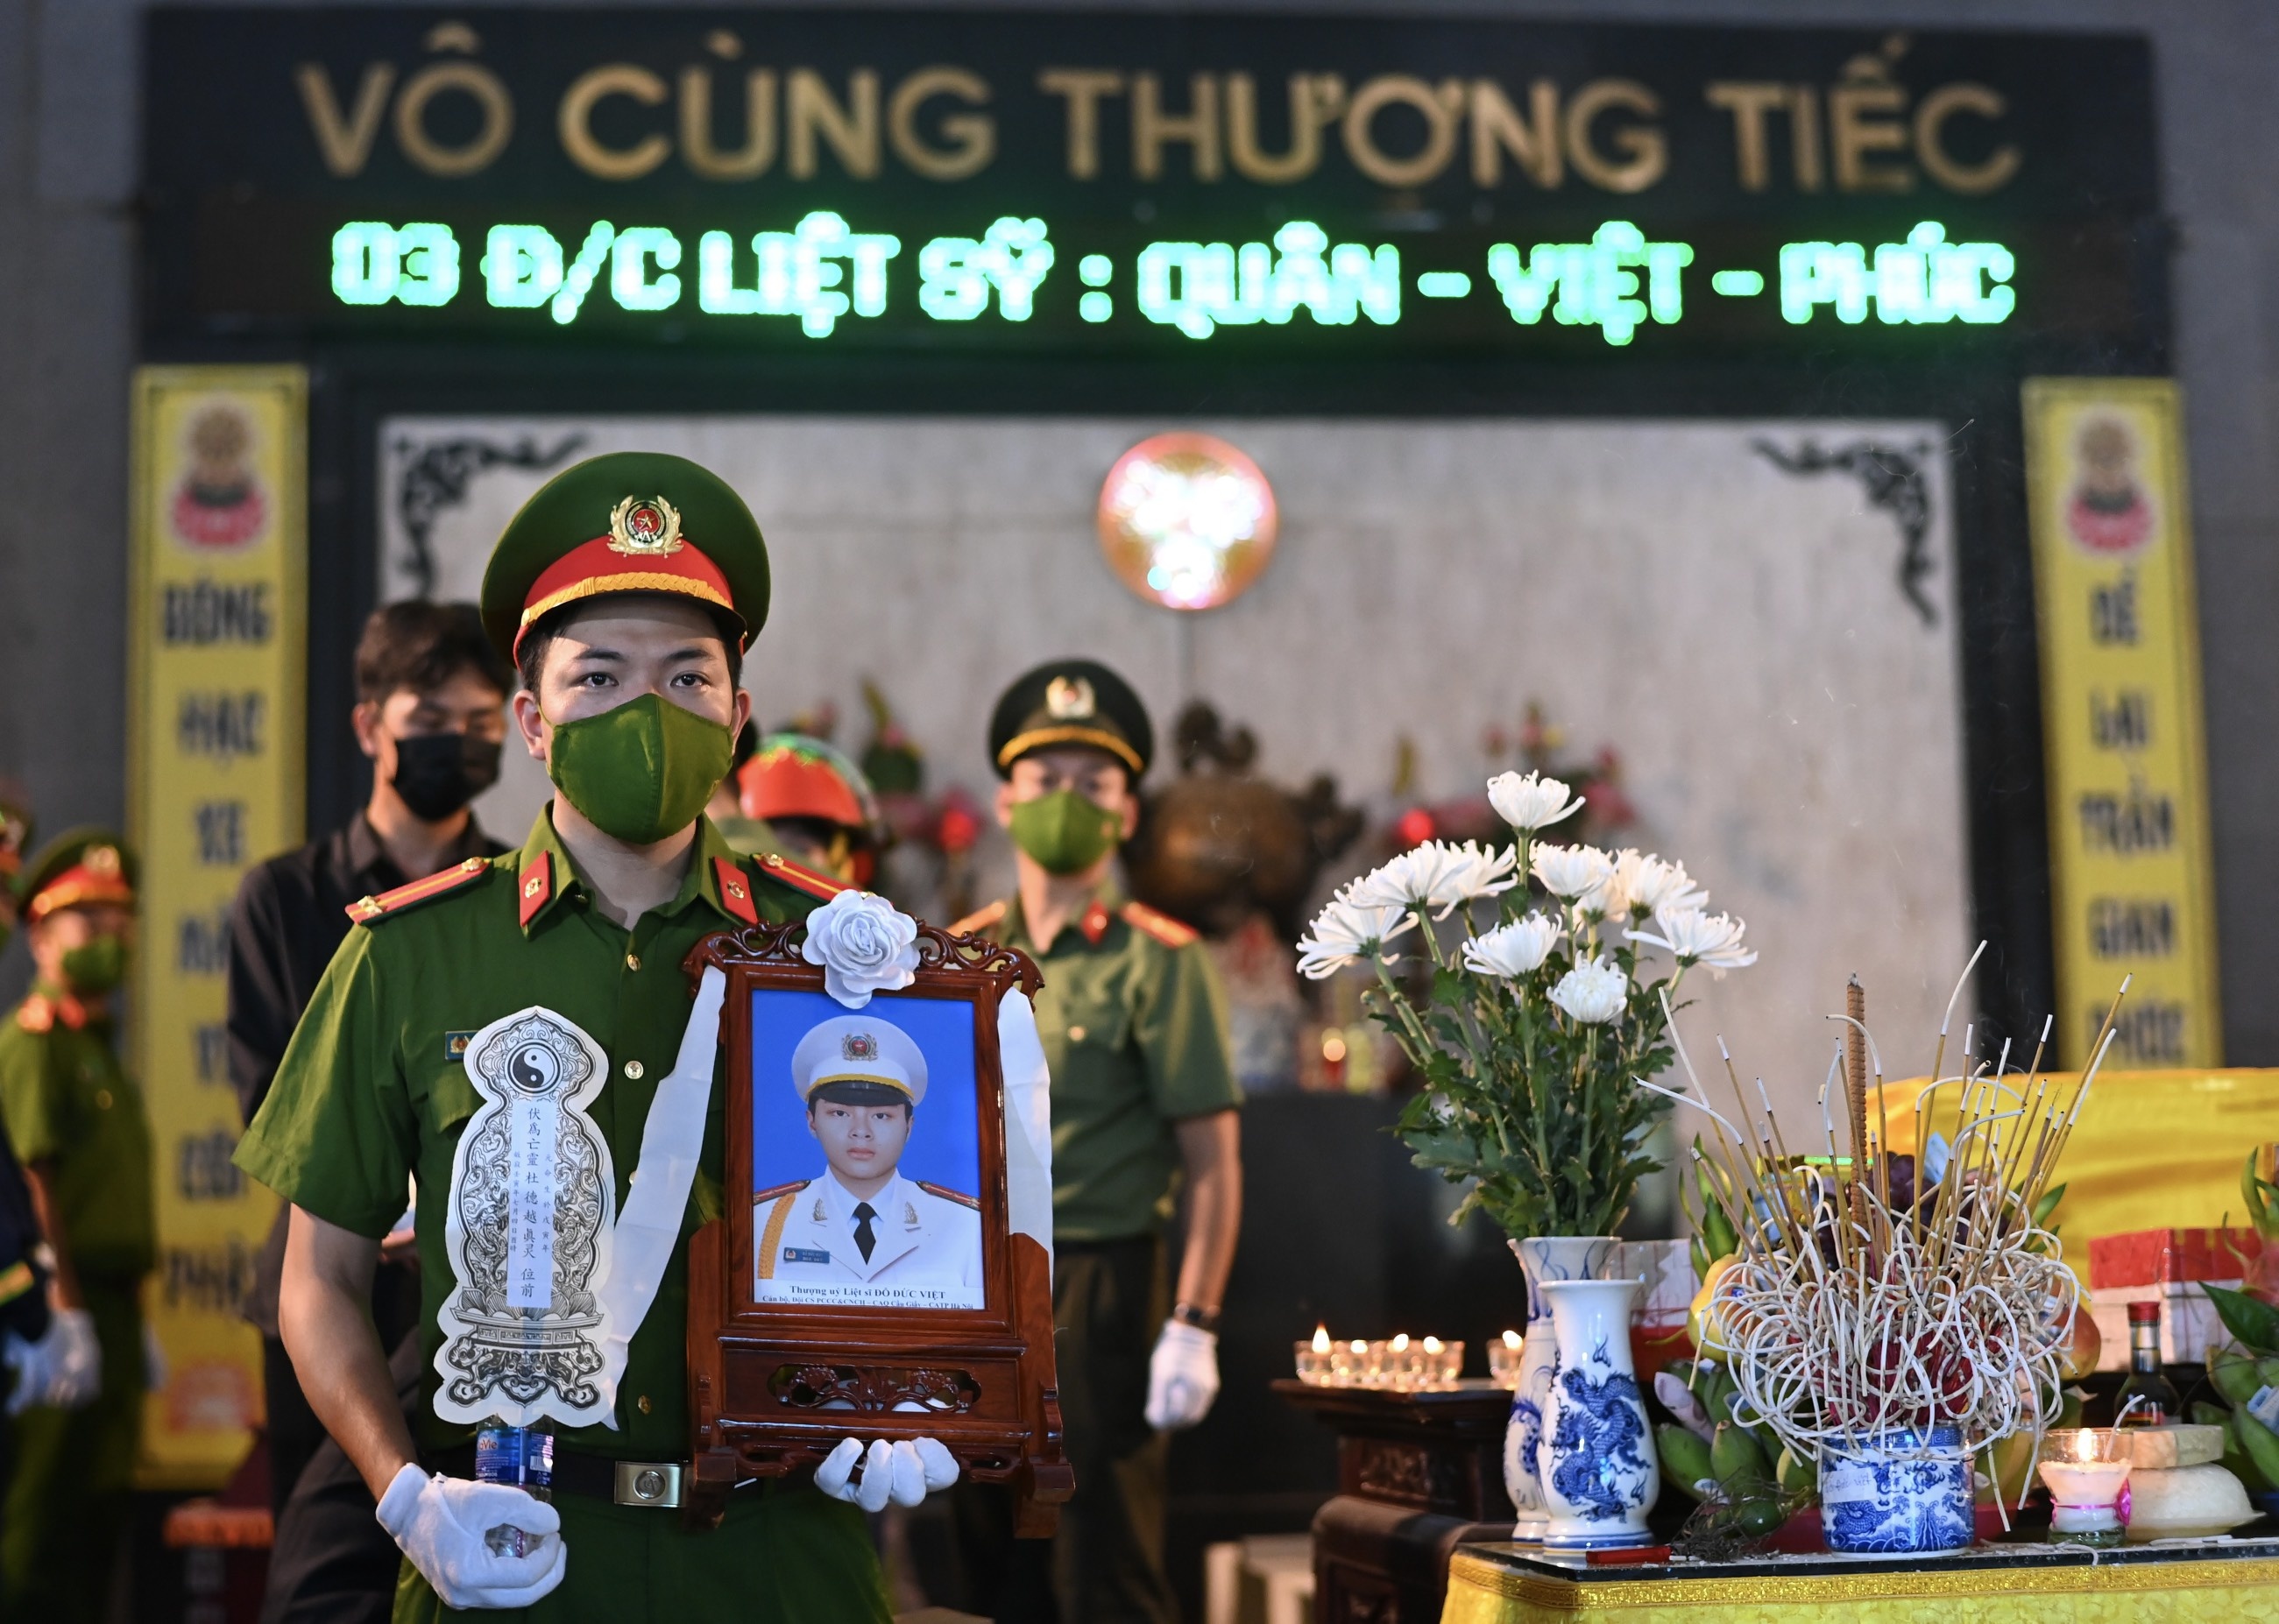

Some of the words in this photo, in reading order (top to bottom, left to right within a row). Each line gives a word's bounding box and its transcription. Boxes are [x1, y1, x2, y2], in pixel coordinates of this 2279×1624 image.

[300, 25, 513, 175] VÔ
[558, 30, 995, 180] CÙNG
[1039, 70, 1669, 194] THƯƠNG
[1705, 35, 2021, 191] TIẾC
[332, 222, 460, 306] 03
[480, 221, 681, 324] Đ/C
[699, 211, 901, 338] LIỆT
[919, 217, 1054, 321] SỸ
[1137, 222, 1400, 339] QUÂN
[1488, 222, 1694, 345] VIỆT
[1780, 222, 2014, 324] PHÚC
[790, 1286, 826, 1296] Thượng
[844, 1288, 861, 1297] Liệt
[893, 1288, 917, 1298] ĐỨC
[919, 1289, 946, 1301] VIỆT
